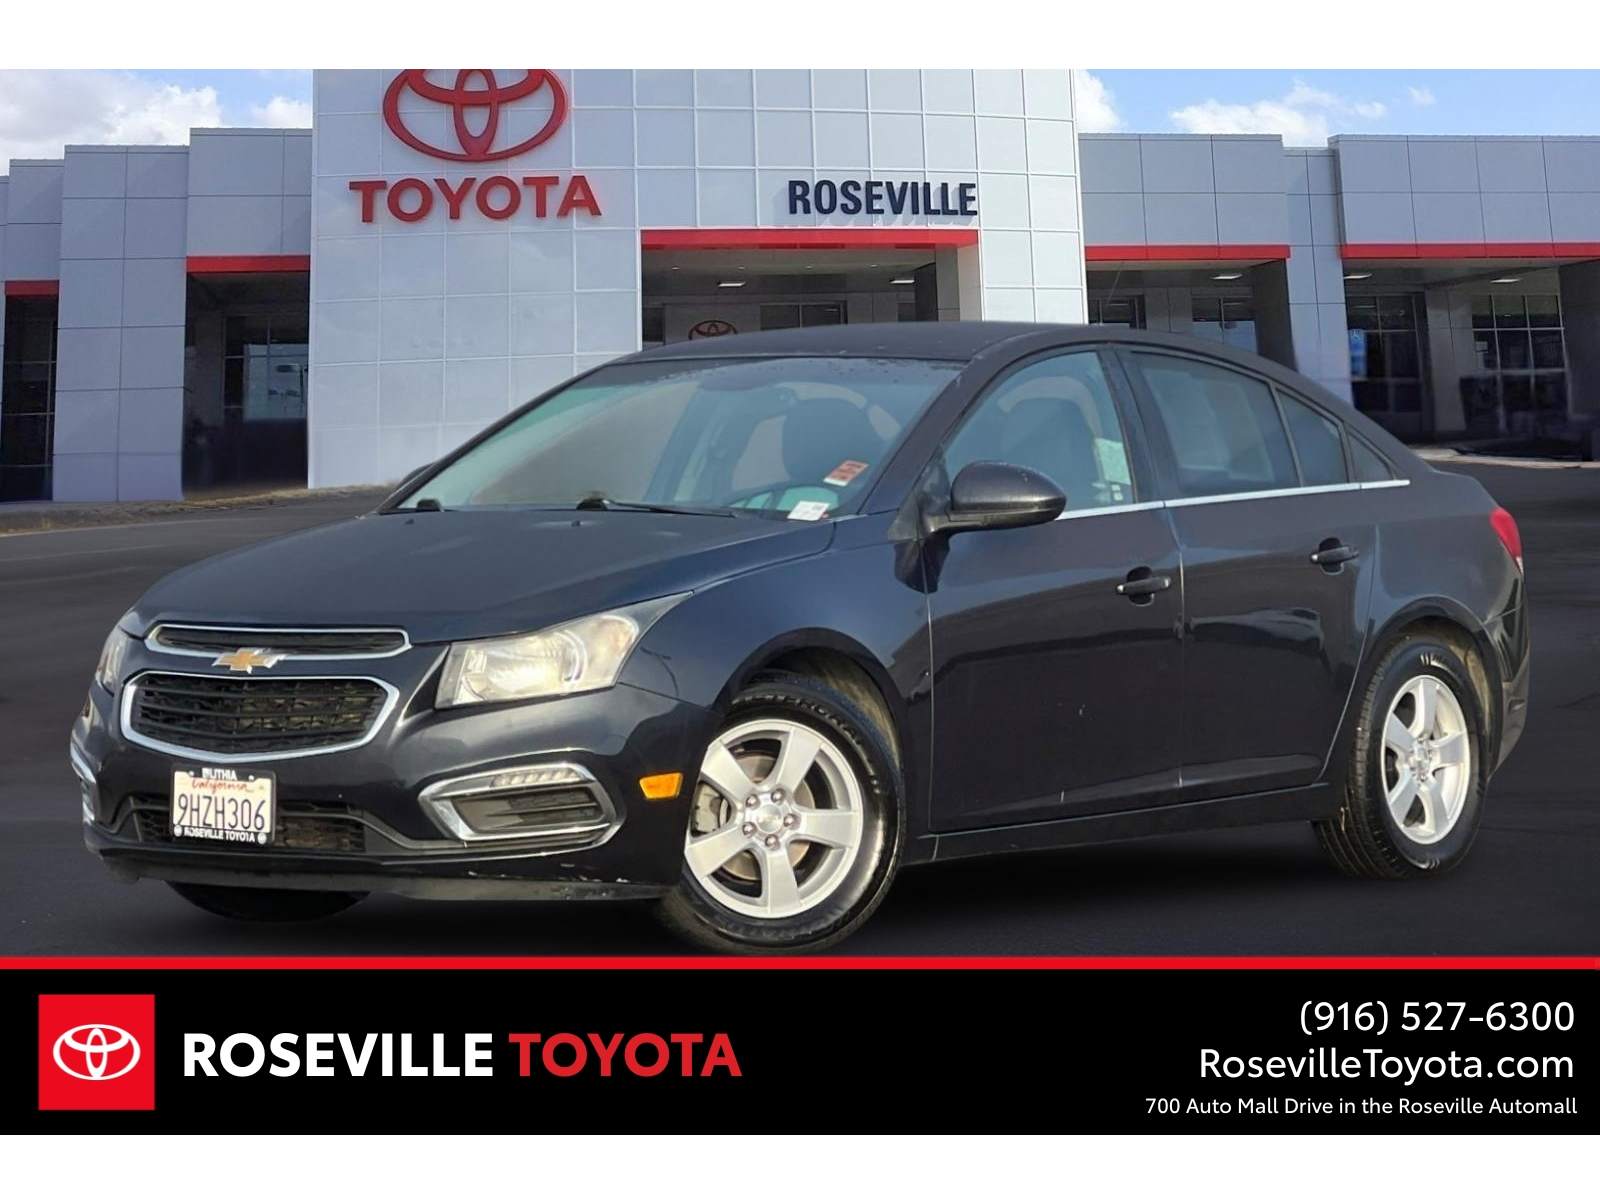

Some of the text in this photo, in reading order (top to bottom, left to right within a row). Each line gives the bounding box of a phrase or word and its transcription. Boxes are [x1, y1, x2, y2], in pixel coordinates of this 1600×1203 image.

[349, 175, 602, 224] TOYOTA
[788, 179, 979, 217] ROSEVILLE
[177, 793, 266, 831] 9HZH306
[184, 827, 256, 843] ROSEVILLE TOYOTA
